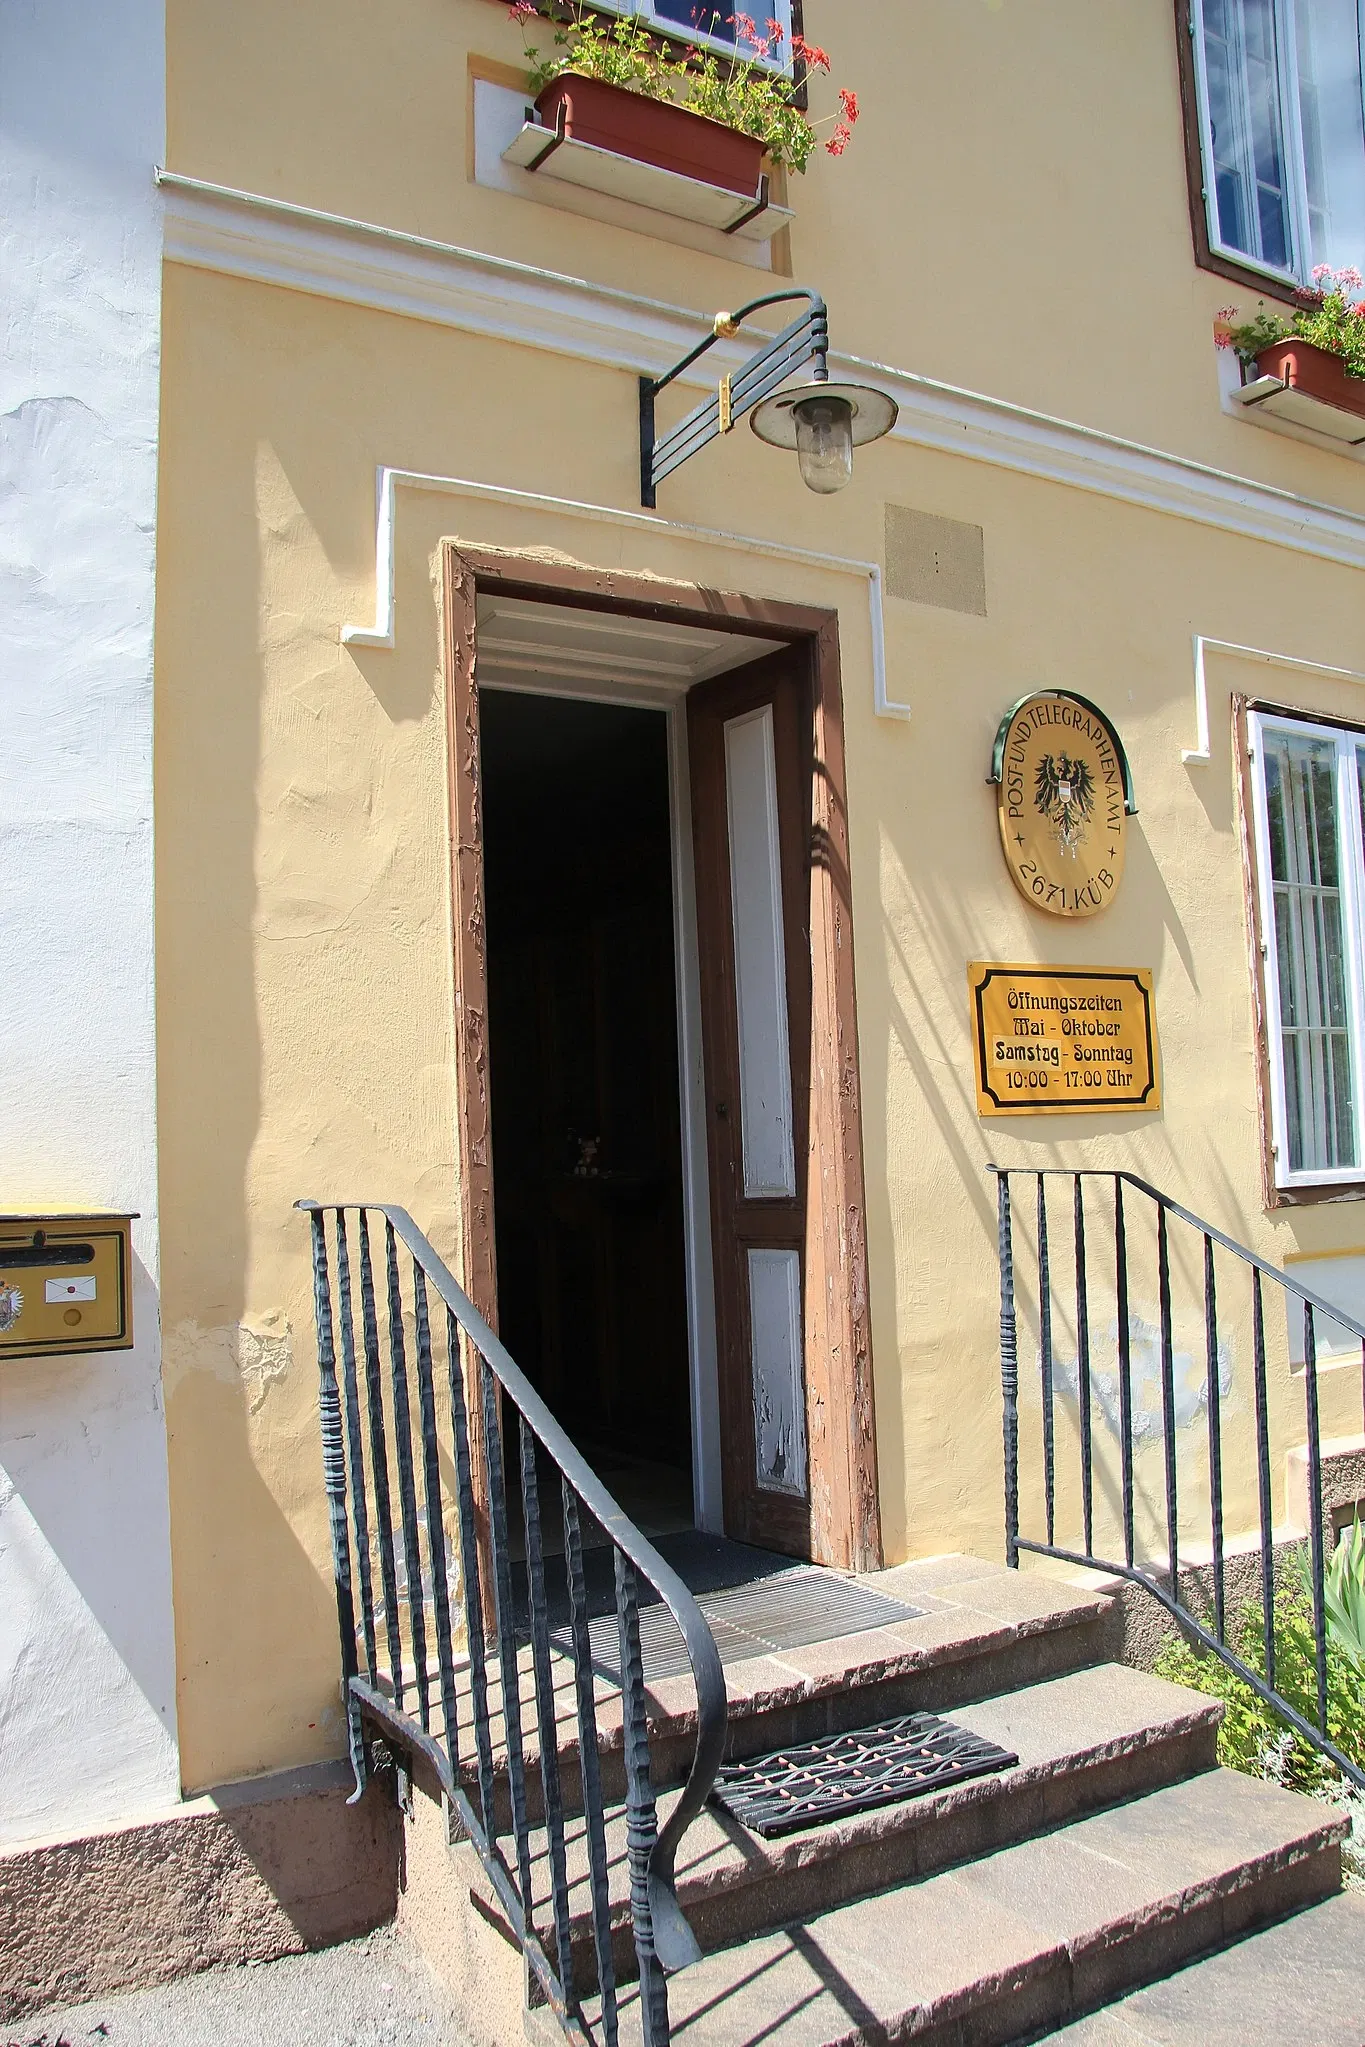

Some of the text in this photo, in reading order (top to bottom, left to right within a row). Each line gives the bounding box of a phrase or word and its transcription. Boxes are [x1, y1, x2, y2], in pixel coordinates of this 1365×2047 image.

[1026, 704, 1121, 835] TELEGRAPHENAMT
[1008, 988, 1123, 1014] Öffnungszeiten
[1013, 1018, 1045, 1036] Mai
[1061, 1018, 1120, 1036] Oktober
[995, 1042, 1059, 1066] Samstag
[1073, 1044, 1133, 1064] Sonntag
[1006, 1071, 1048, 1088] 10:00
[1064, 1070, 1101, 1087] 17:00
[1107, 1069, 1133, 1087] Uhr
